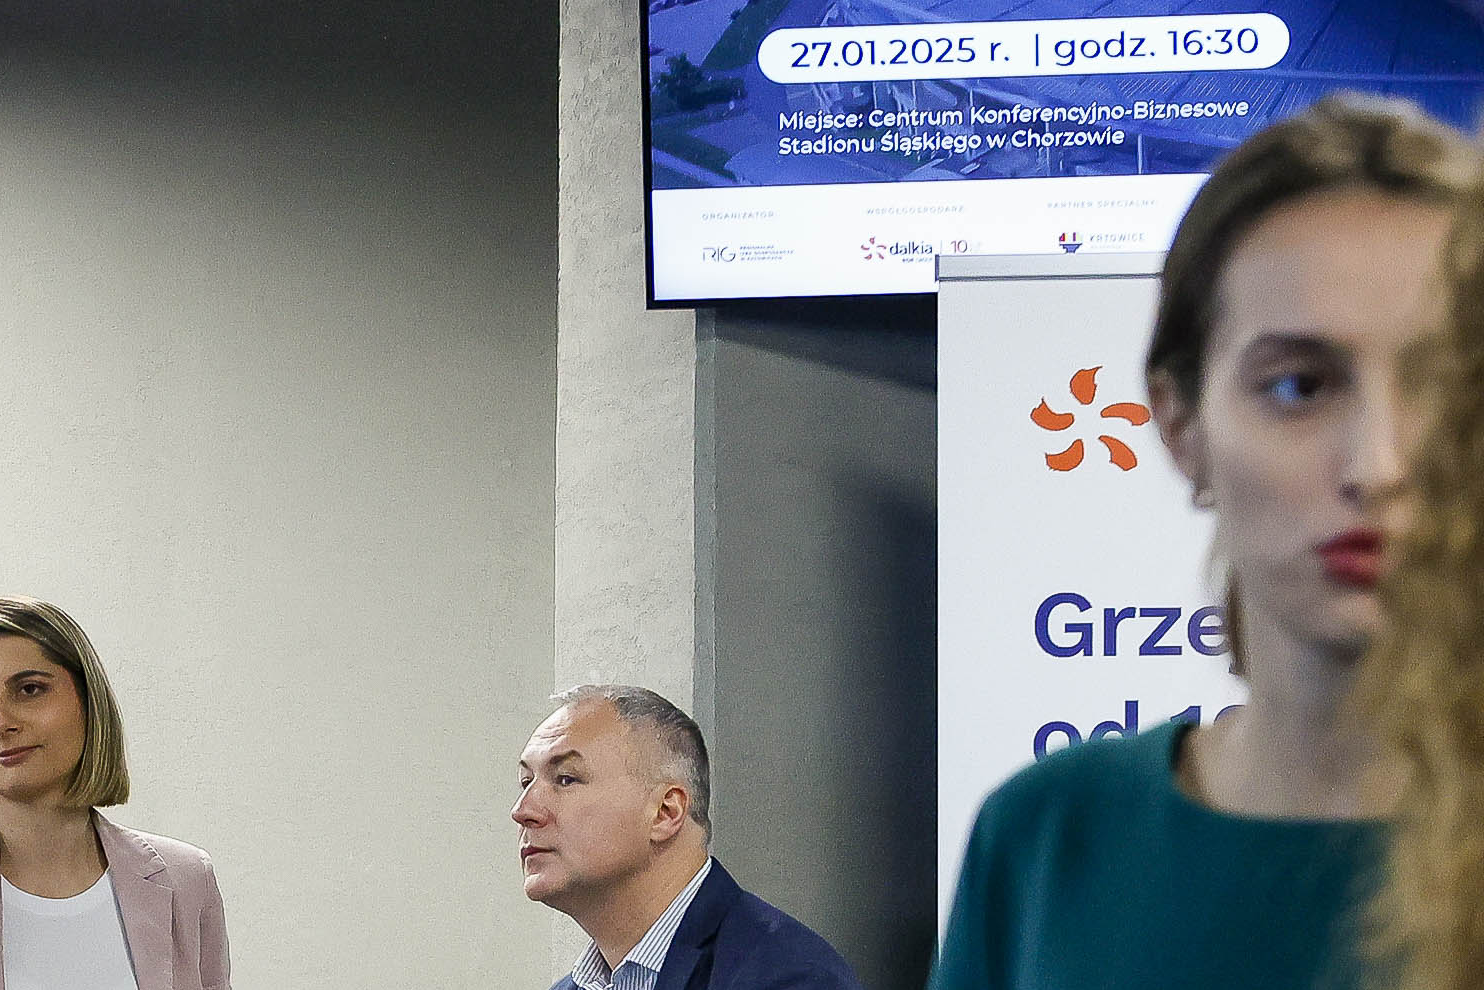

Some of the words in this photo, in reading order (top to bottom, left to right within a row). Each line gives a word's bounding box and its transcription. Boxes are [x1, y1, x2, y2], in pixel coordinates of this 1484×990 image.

[790, 37, 976, 68] 27.01.2025
[990, 41, 1010, 61] r.
[1054, 31, 1156, 66] godz.
[1167, 28, 1259, 56] 16:30
[778, 109, 864, 133] Miejsce:
[868, 109, 963, 128] Centrum
[970, 99, 1249, 125] Konferencyjno-Biznesowe
[778, 134, 875, 155] Stadionu
[880, 129, 981, 156] Śląskiego
[985, 133, 1007, 144] w
[1011, 126, 1125, 148] Chorzowie
[889, 240, 933, 256] dalkia
[1034, 591, 1232, 657] Grze
